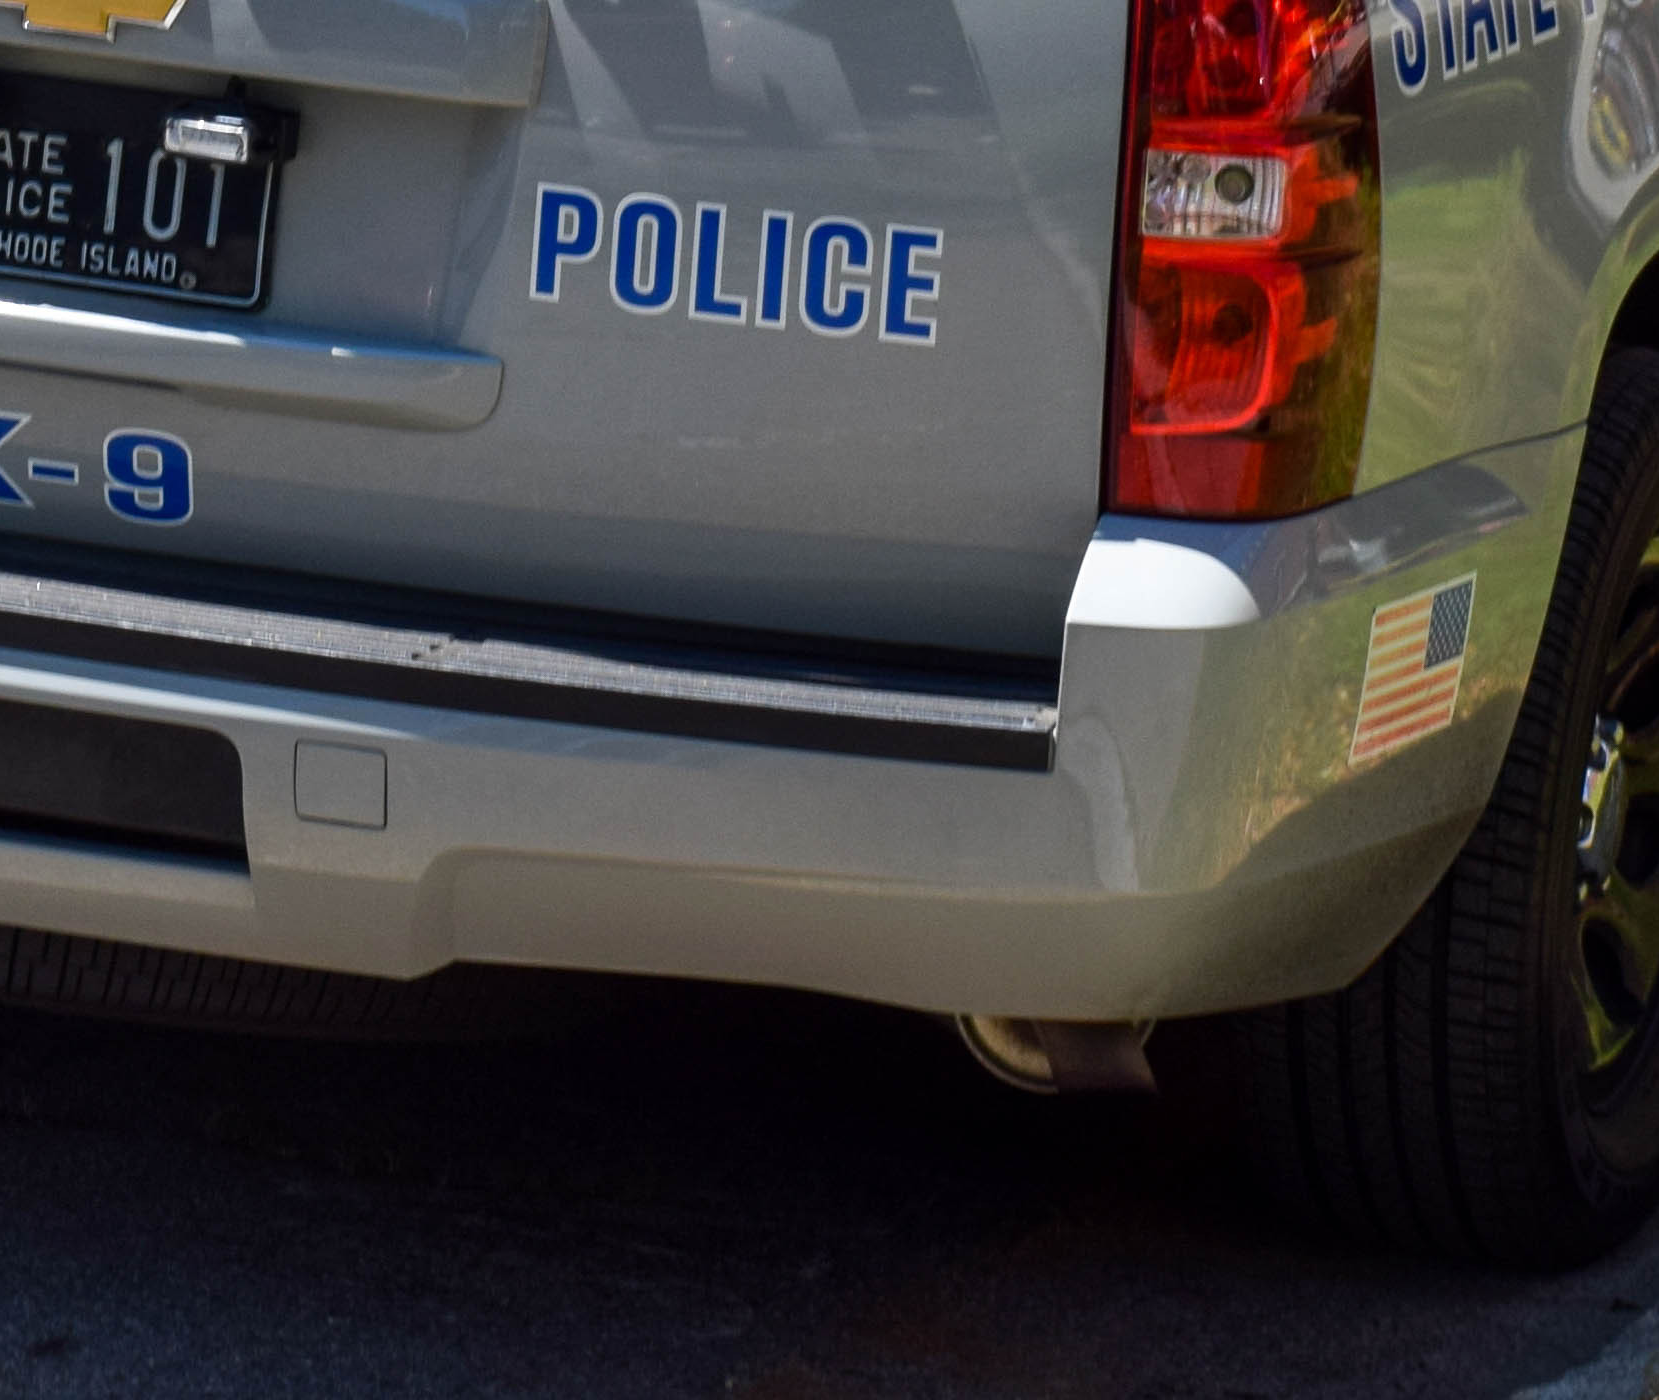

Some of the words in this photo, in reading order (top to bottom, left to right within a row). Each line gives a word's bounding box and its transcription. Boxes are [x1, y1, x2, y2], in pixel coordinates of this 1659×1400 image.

[102, 137, 229, 249] 101
[79, 241, 178, 285] ISLAND
[528, 181, 945, 347] POLICE
